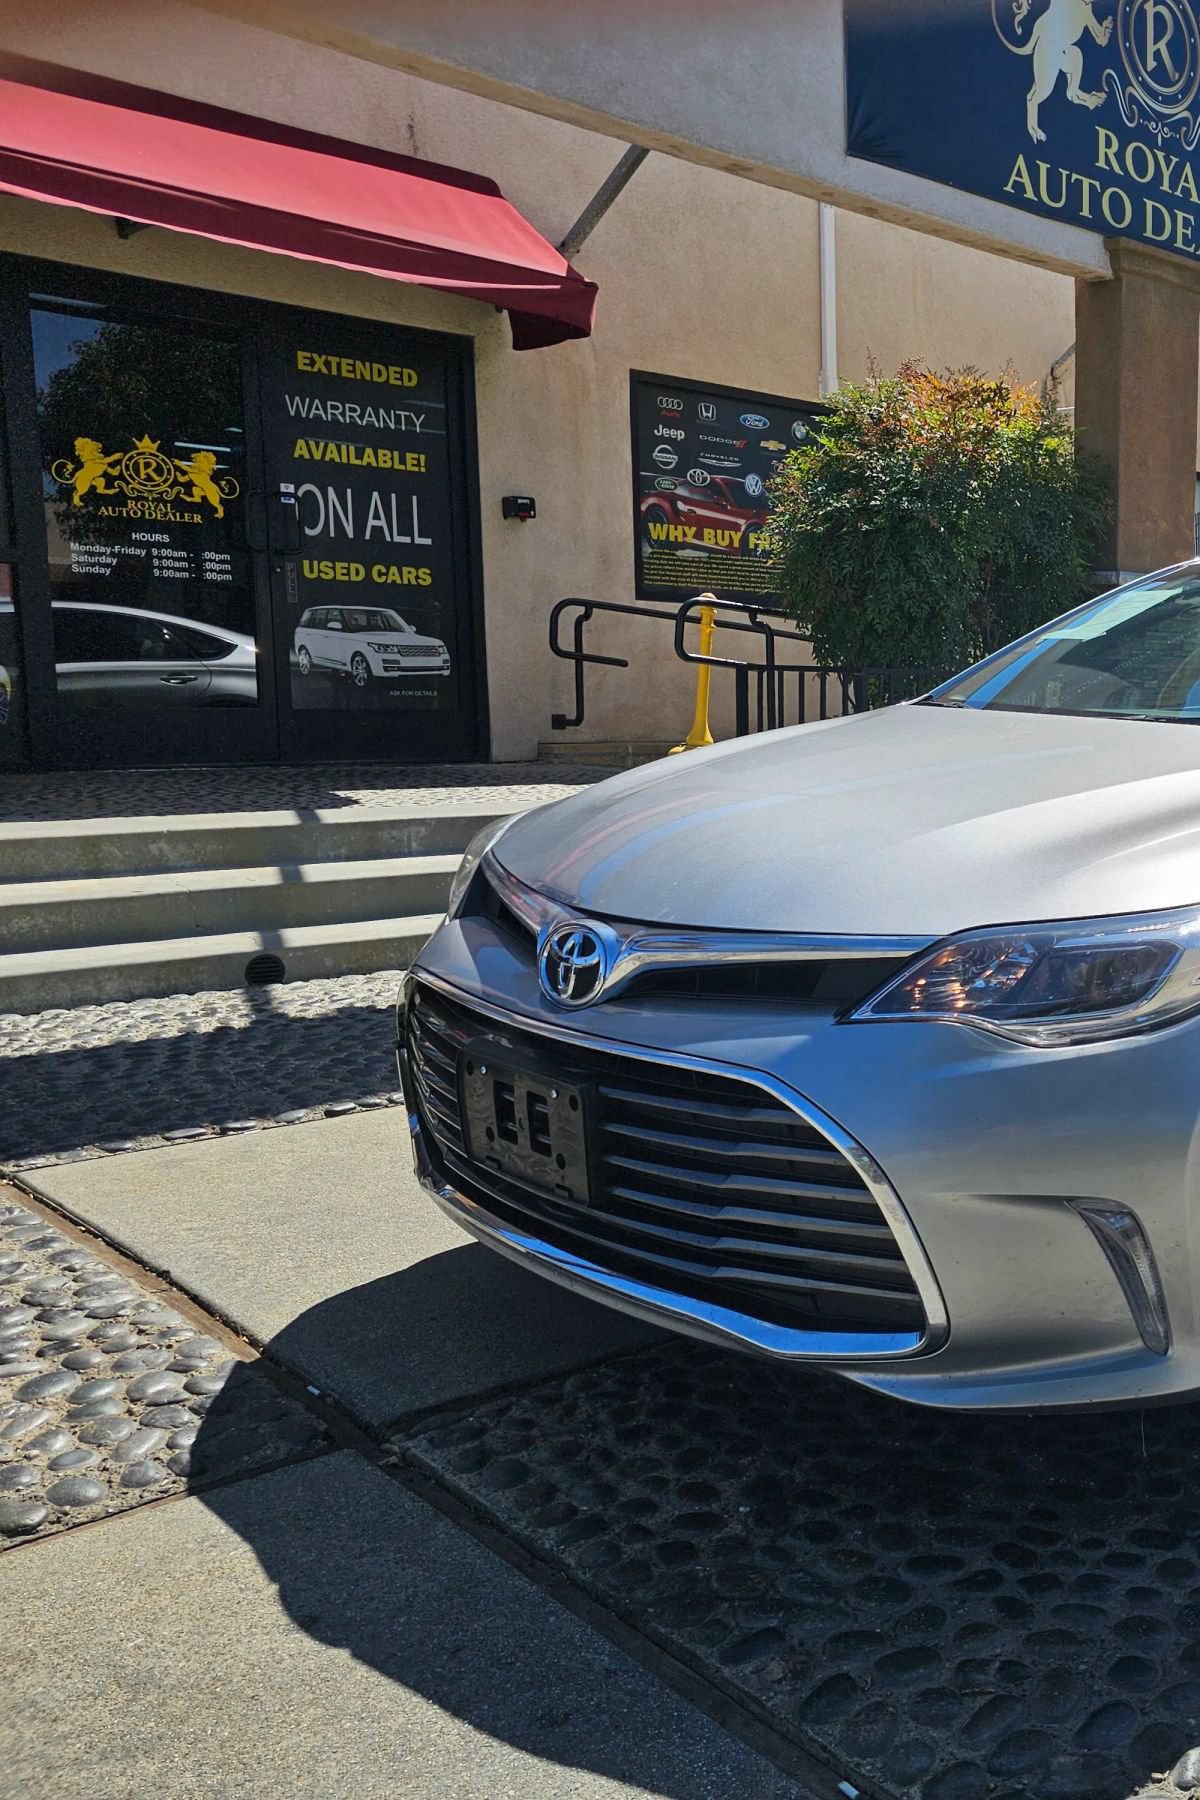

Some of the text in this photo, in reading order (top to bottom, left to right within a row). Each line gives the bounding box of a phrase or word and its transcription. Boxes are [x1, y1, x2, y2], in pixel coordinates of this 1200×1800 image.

[1003, 153, 1133, 230] AUTO
[296, 350, 418, 388] EXTENDED
[284, 394, 426, 433] WARRANTY
[745, 415, 764, 428] Ford
[653, 424, 686, 442] Jeep
[293, 438, 426, 473] AVAILABLE!
[700, 452, 740, 462] CHRYSLER
[137, 457, 161, 481] R
[98, 505, 204, 524] AUTO DEALER
[128, 499, 176, 513] ROYAL
[364, 490, 433, 546] ALL
[131, 532, 170, 543] HOURS
[647, 522, 697, 543] WHY
[703, 527, 742, 548] BUY
[69, 542, 147, 557] Monday-Friday
[151, 548, 188, 559] 9:00am
[71, 553, 118, 566] Saturday
[152, 558, 189, 569] 9:00am
[71, 563, 112, 576] Sunday
[153, 568, 190, 579] 9:00am
[302, 559, 433, 586] USED CARS
